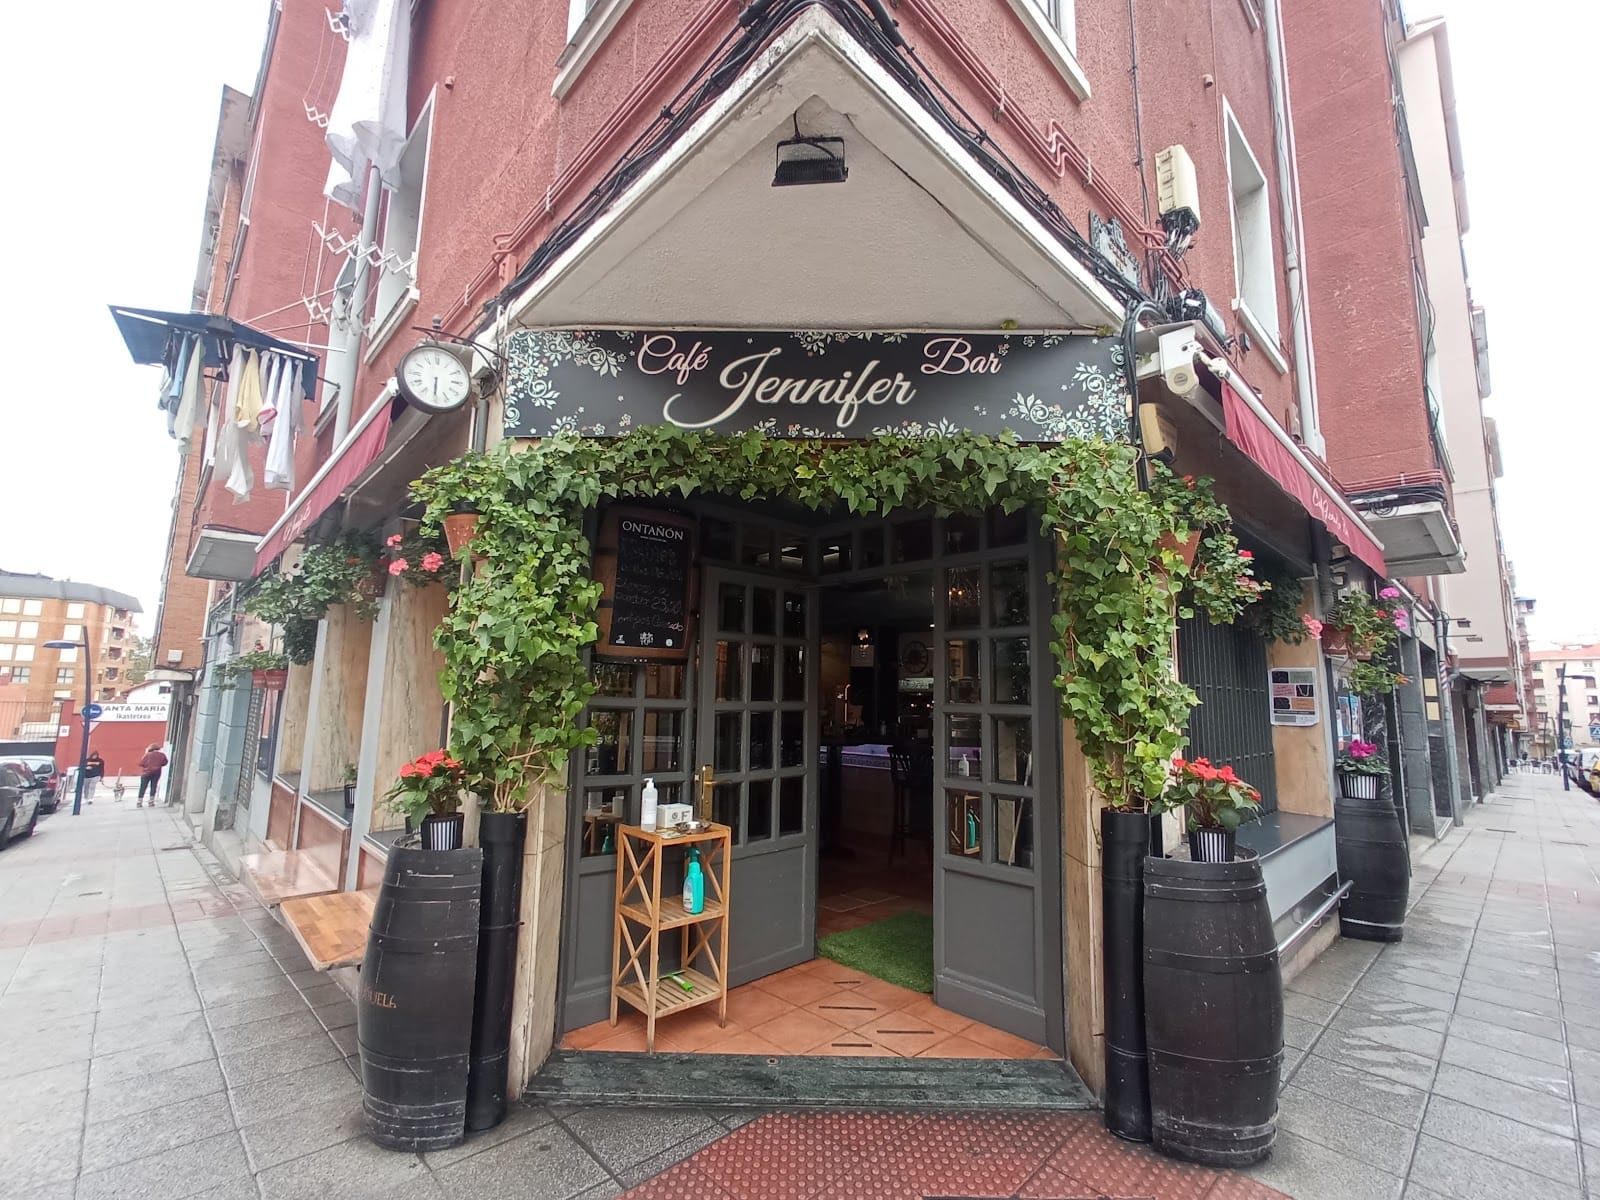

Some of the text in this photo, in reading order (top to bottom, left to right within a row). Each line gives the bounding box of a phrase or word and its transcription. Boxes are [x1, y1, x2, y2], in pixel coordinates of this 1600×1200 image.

[637, 334, 1002, 385] Café Bar
[663, 347, 916, 428] Jennifer
[622, 520, 684, 540] ONTAÑÓN
